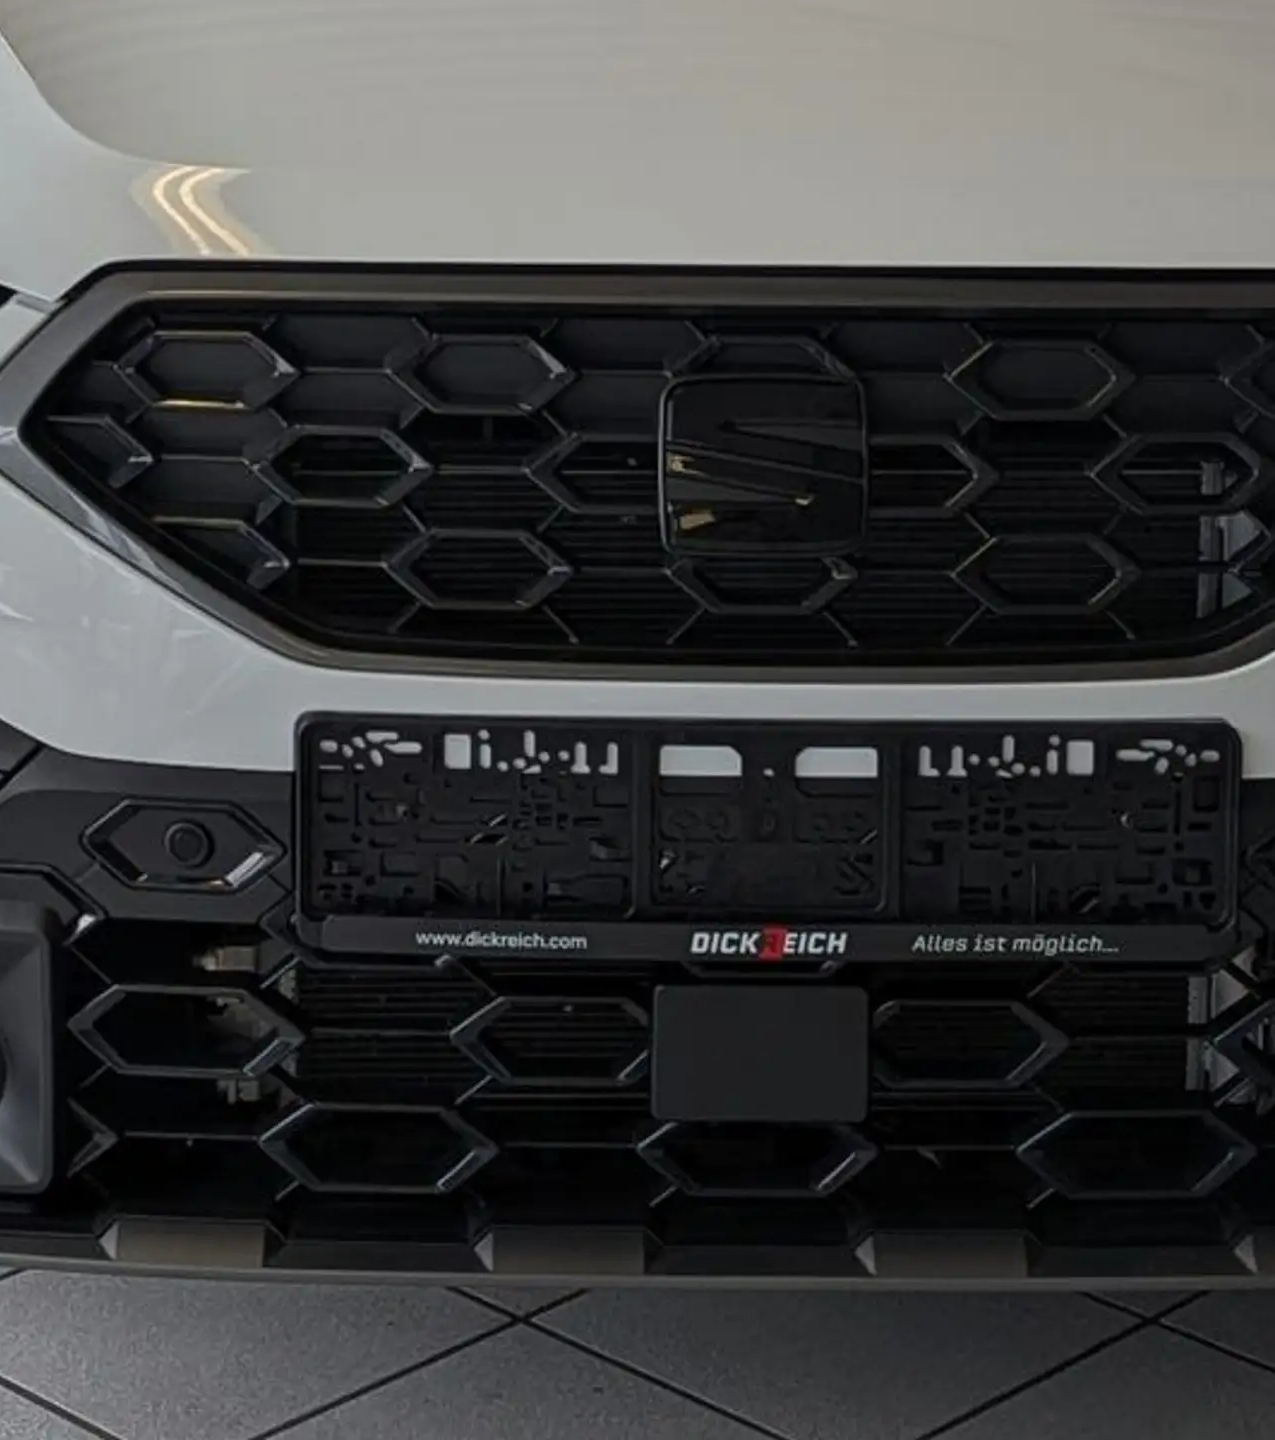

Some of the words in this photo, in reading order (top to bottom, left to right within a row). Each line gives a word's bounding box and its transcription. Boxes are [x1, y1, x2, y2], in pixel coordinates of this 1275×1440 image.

[415, 931, 587, 950] www.dickreich.com
[911, 934, 969, 953] Alles
[973, 934, 1007, 952] ist
